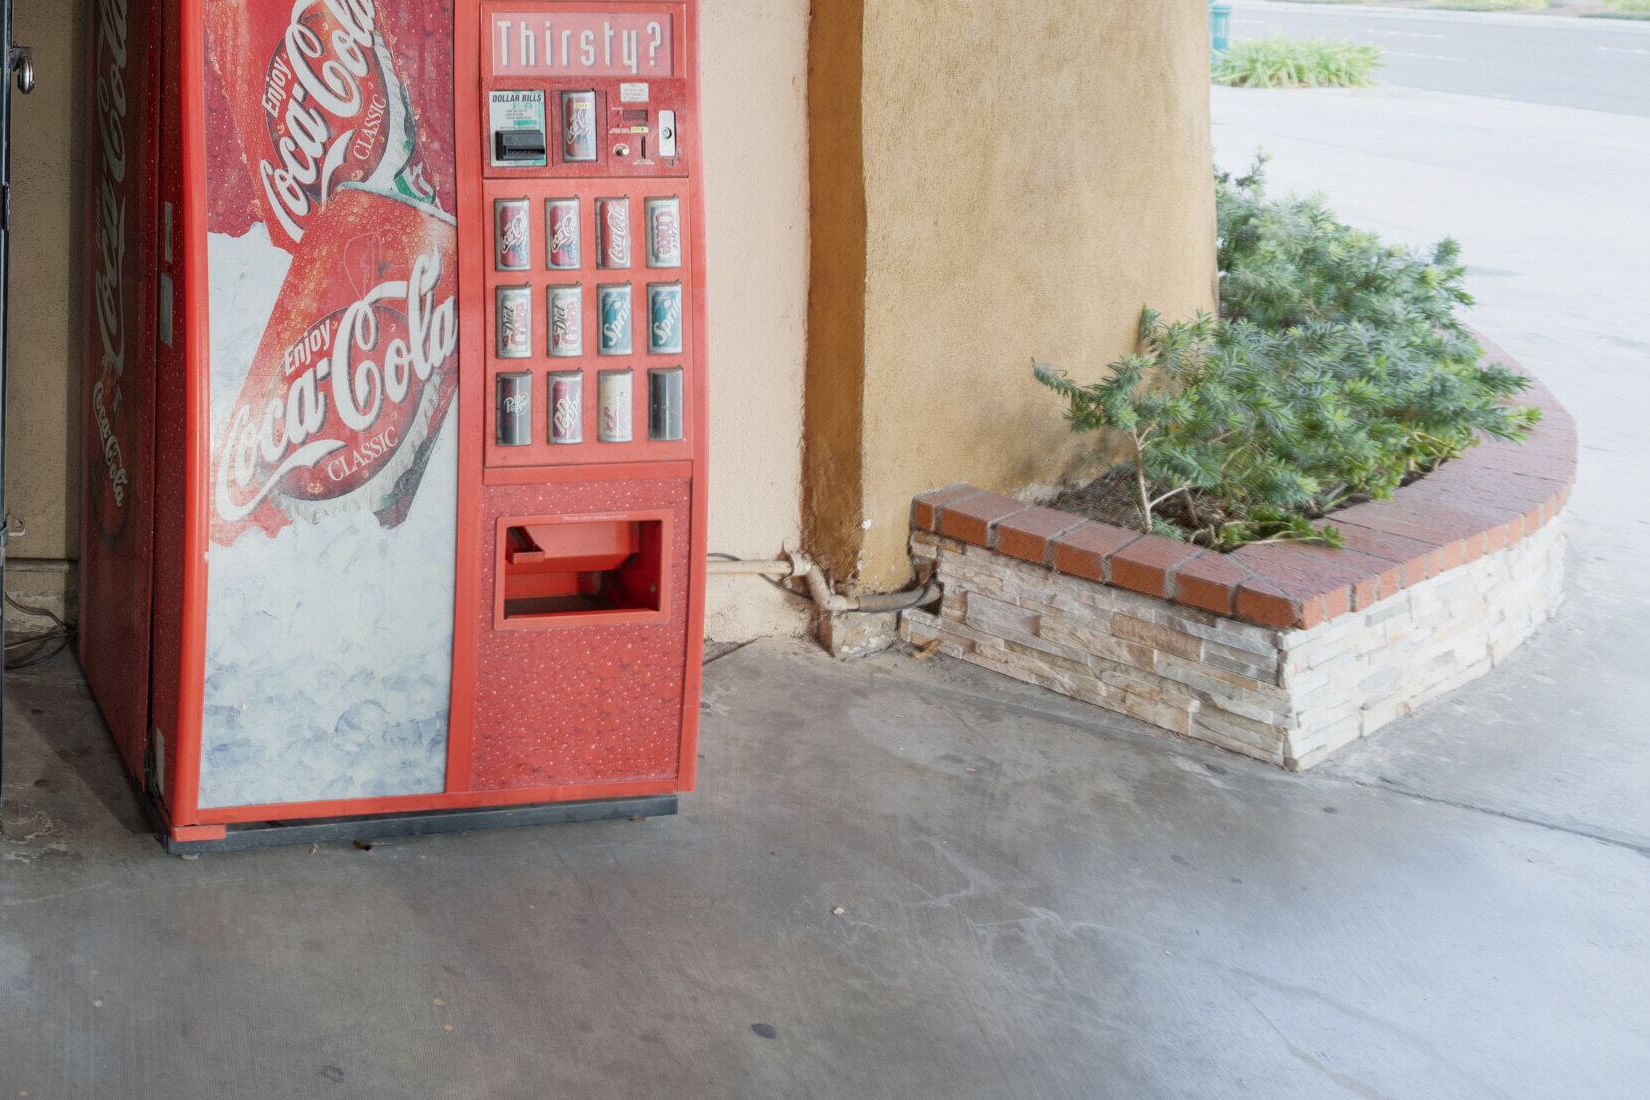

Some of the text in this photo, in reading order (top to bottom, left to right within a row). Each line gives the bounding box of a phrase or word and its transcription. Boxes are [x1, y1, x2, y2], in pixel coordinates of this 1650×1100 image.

[497, 19, 663, 74] Thirsty?
[261, 55, 292, 118] Enjoy
[492, 94, 542, 103] DOLLAR BILLS
[353, 93, 388, 160] CLASSIC
[283, 318, 331, 377] Enjoy
[215, 241, 458, 521] Coca-Cola
[327, 426, 399, 481] CLASSIC
